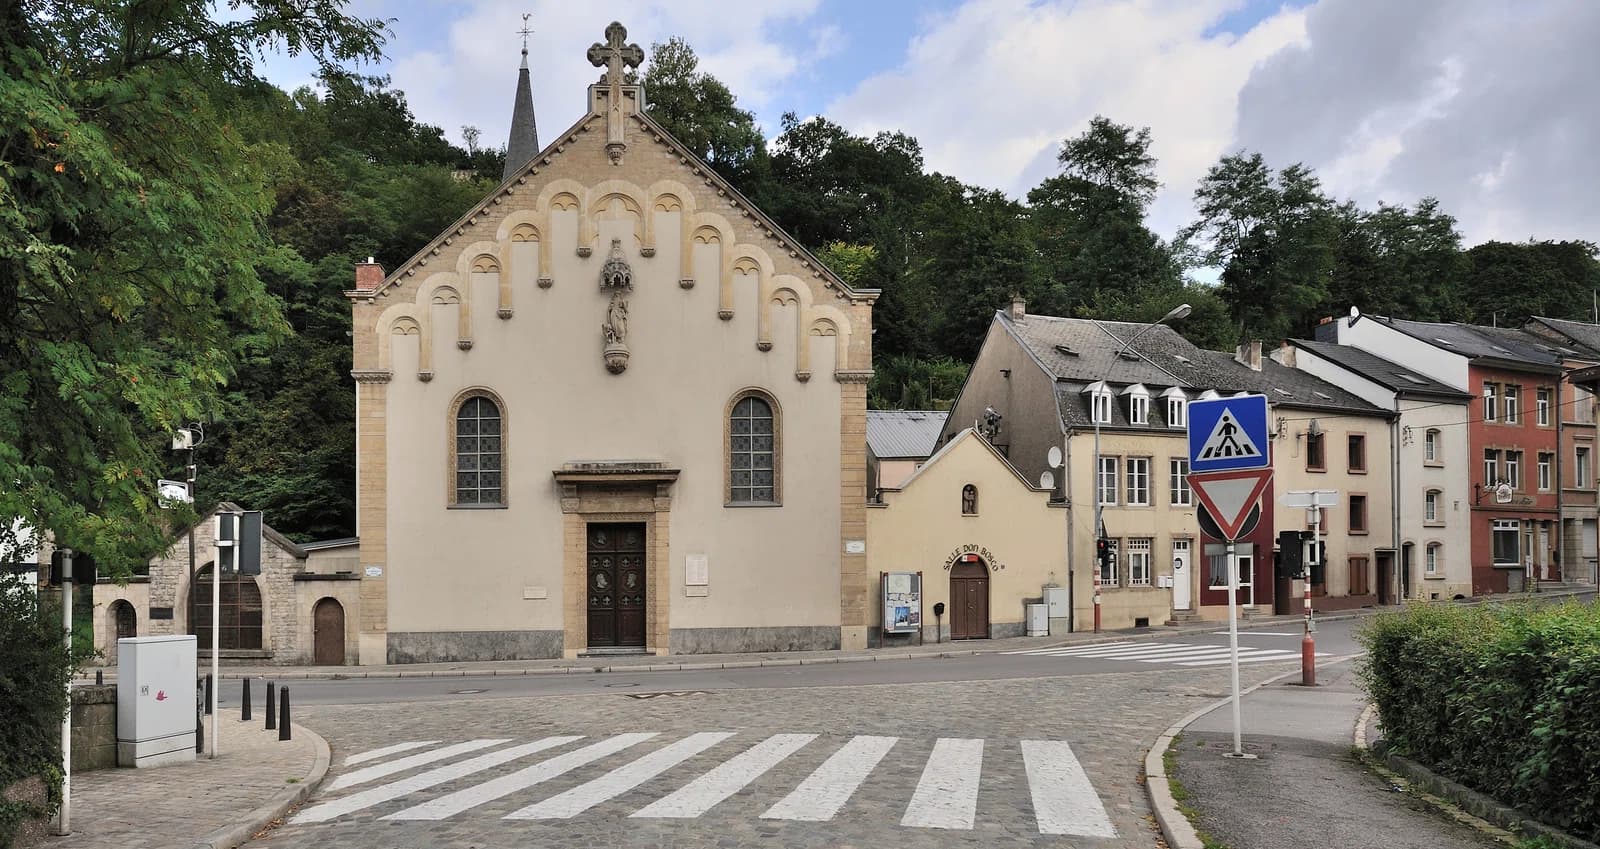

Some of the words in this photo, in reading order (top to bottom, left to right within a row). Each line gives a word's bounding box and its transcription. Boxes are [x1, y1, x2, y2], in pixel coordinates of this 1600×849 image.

[943, 547, 962, 571] SALLE
[963, 544, 979, 552] DON
[980, 547, 999, 571] BOSCO
